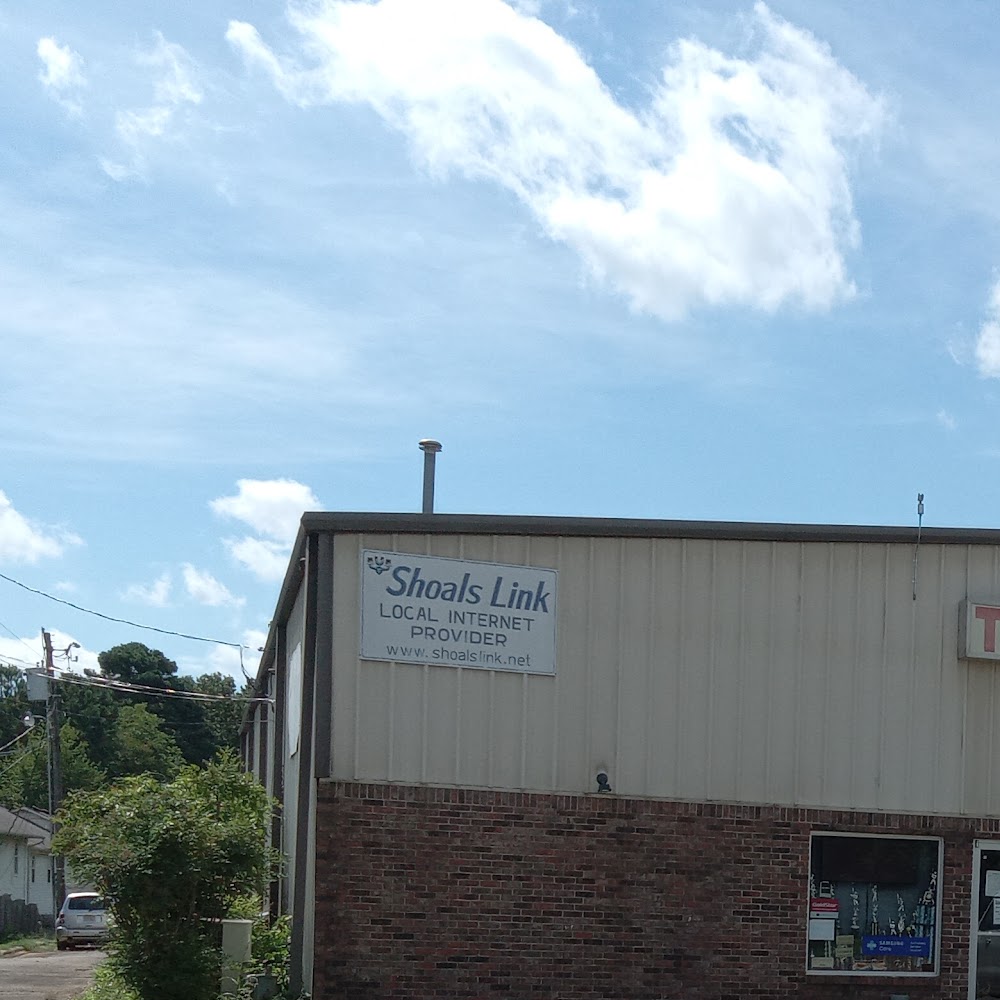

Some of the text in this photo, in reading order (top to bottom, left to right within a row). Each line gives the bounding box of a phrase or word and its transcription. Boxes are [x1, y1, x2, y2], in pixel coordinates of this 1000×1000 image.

[386, 565, 551, 613] Shoals Link
[380, 603, 535, 631] LOCAL INTERNET
[411, 626, 508, 647] PROVIDER
